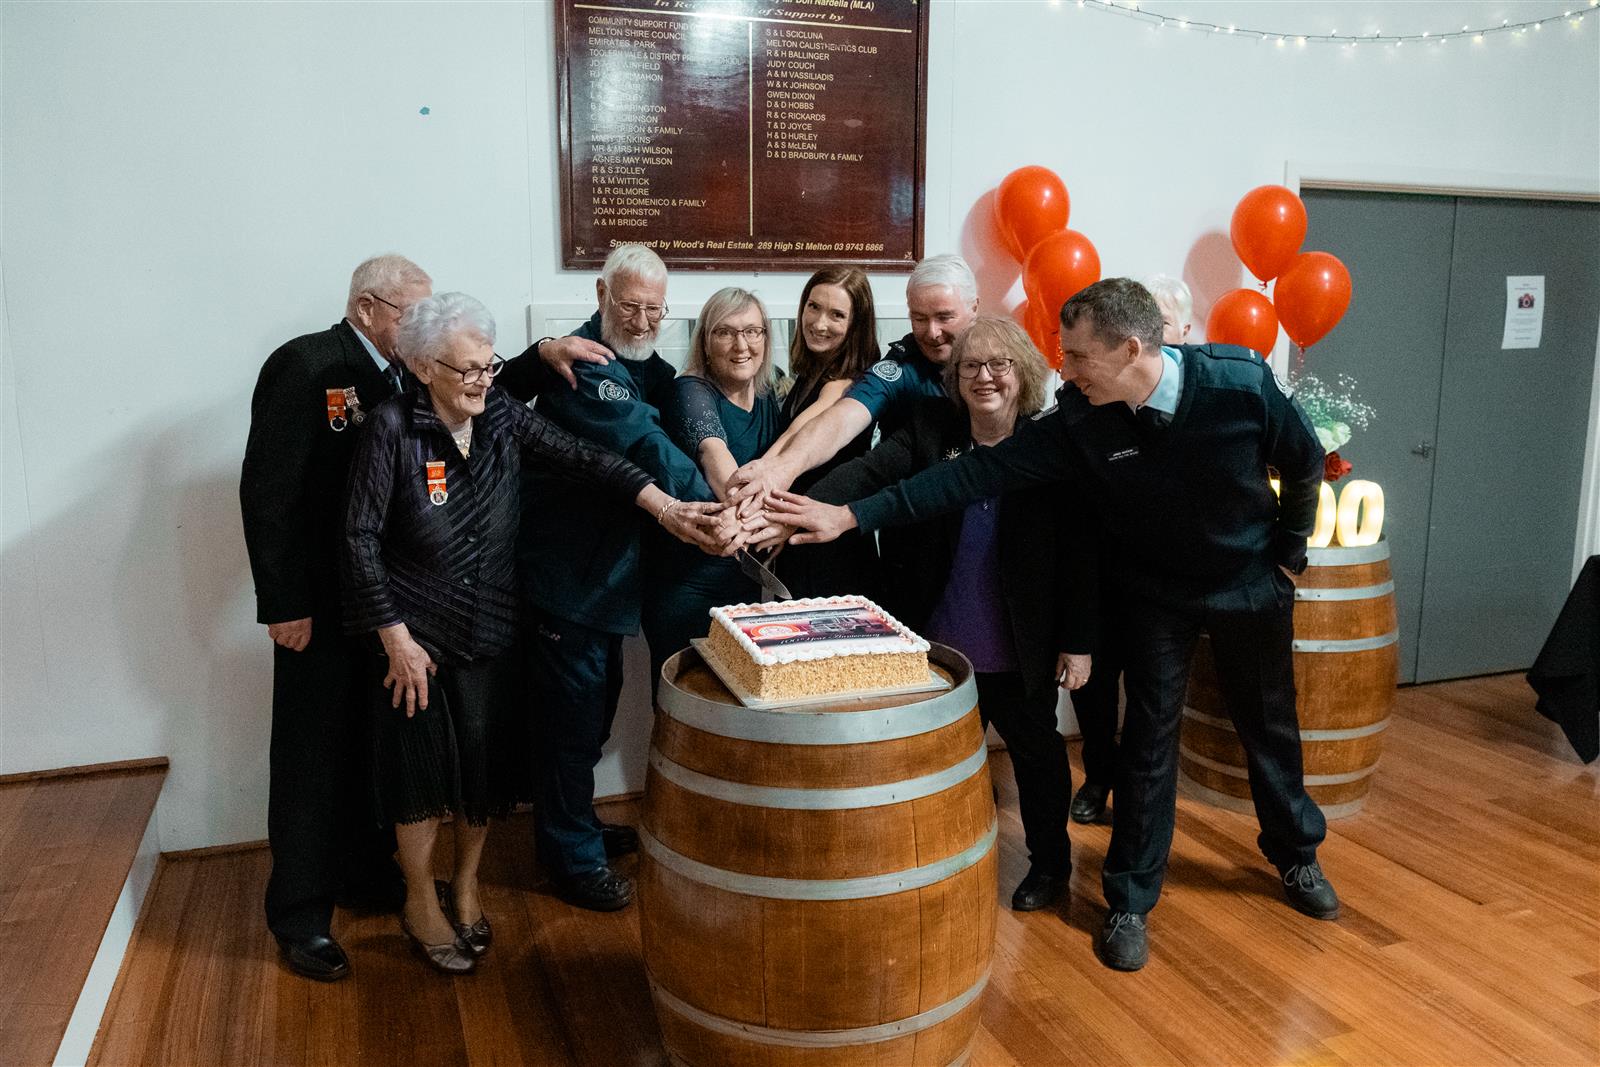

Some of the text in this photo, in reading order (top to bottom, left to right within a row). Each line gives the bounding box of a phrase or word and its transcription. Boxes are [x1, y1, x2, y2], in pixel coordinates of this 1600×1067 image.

[814, 0, 848, 8] Nardella
[850, 1, 874, 11] (MLA)
[758, 8, 774, 16] of
[775, 8, 826, 19] Support
[829, 13, 844, 21] by
[588, 16, 632, 26] COMMUNITY
[634, 18, 668, 29] SUPPORT
[669, 22, 688, 31] FUND
[589, 27, 685, 40] MELTON SHIRE COUNCIL
[766, 28, 771, 36] S
[780, 29, 784, 37] L
[786, 30, 824, 40] SCICLUNA
[589, 38, 656, 49] EMIRATES PARK
[766, 40, 798, 48] MELTON
[858, 45, 878, 54] CLUB
[649, 52, 681, 61] DISTRICT
[766, 49, 772, 57] R
[788, 51, 830, 60] BALLINGER
[766, 60, 816, 69] JUDY COUCH
[624, 71, 664, 81] MAHON
[774, 70, 780, 78] &
[789, 71, 834, 81] VASSILIADIS
[766, 80, 774, 88] W
[783, 81, 788, 89] K
[790, 82, 826, 91] JOHNSON
[766, 91, 816, 100] GWEN DIXON
[781, 101, 787, 109] D
[788, 102, 814, 110] HOBBS
[766, 111, 772, 119] R
[774, 111, 779, 119] &
[788, 112, 826, 121] RICKARDS
[647, 125, 653, 133] &
[654, 126, 683, 135] FAMILY
[766, 121, 772, 129] T
[780, 122, 786, 130] D
[788, 122, 813, 131] JOYCE
[617, 135, 651, 144] JENKINS
[788, 132, 818, 141] HURLEY
[591, 145, 605, 153] MR
[607, 145, 613, 153] &
[614, 145, 632, 153] MRS
[642, 147, 673, 155] WILSON
[766, 141, 773, 149] A
[788, 142, 817, 150] McLEAN
[592, 154, 673, 165] AGNES MAY WILSON
[781, 151, 787, 159] D
[788, 151, 829, 160] BRADBURY
[837, 153, 864, 161] FAMILY
[592, 166, 646, 175] R & S TOLLEY
[616, 177, 650, 186] WITTICK
[613, 188, 649, 196] GILMORE
[627, 198, 670, 207] DOMENICO
[679, 199, 707, 207] FAMILY
[617, 208, 661, 216] JOHNSTON
[618, 219, 648, 227] BRIDGE
[609, 239, 884, 252] Sponsored by Wood's Real Estate 289 High St Melton 03 9743 6866
